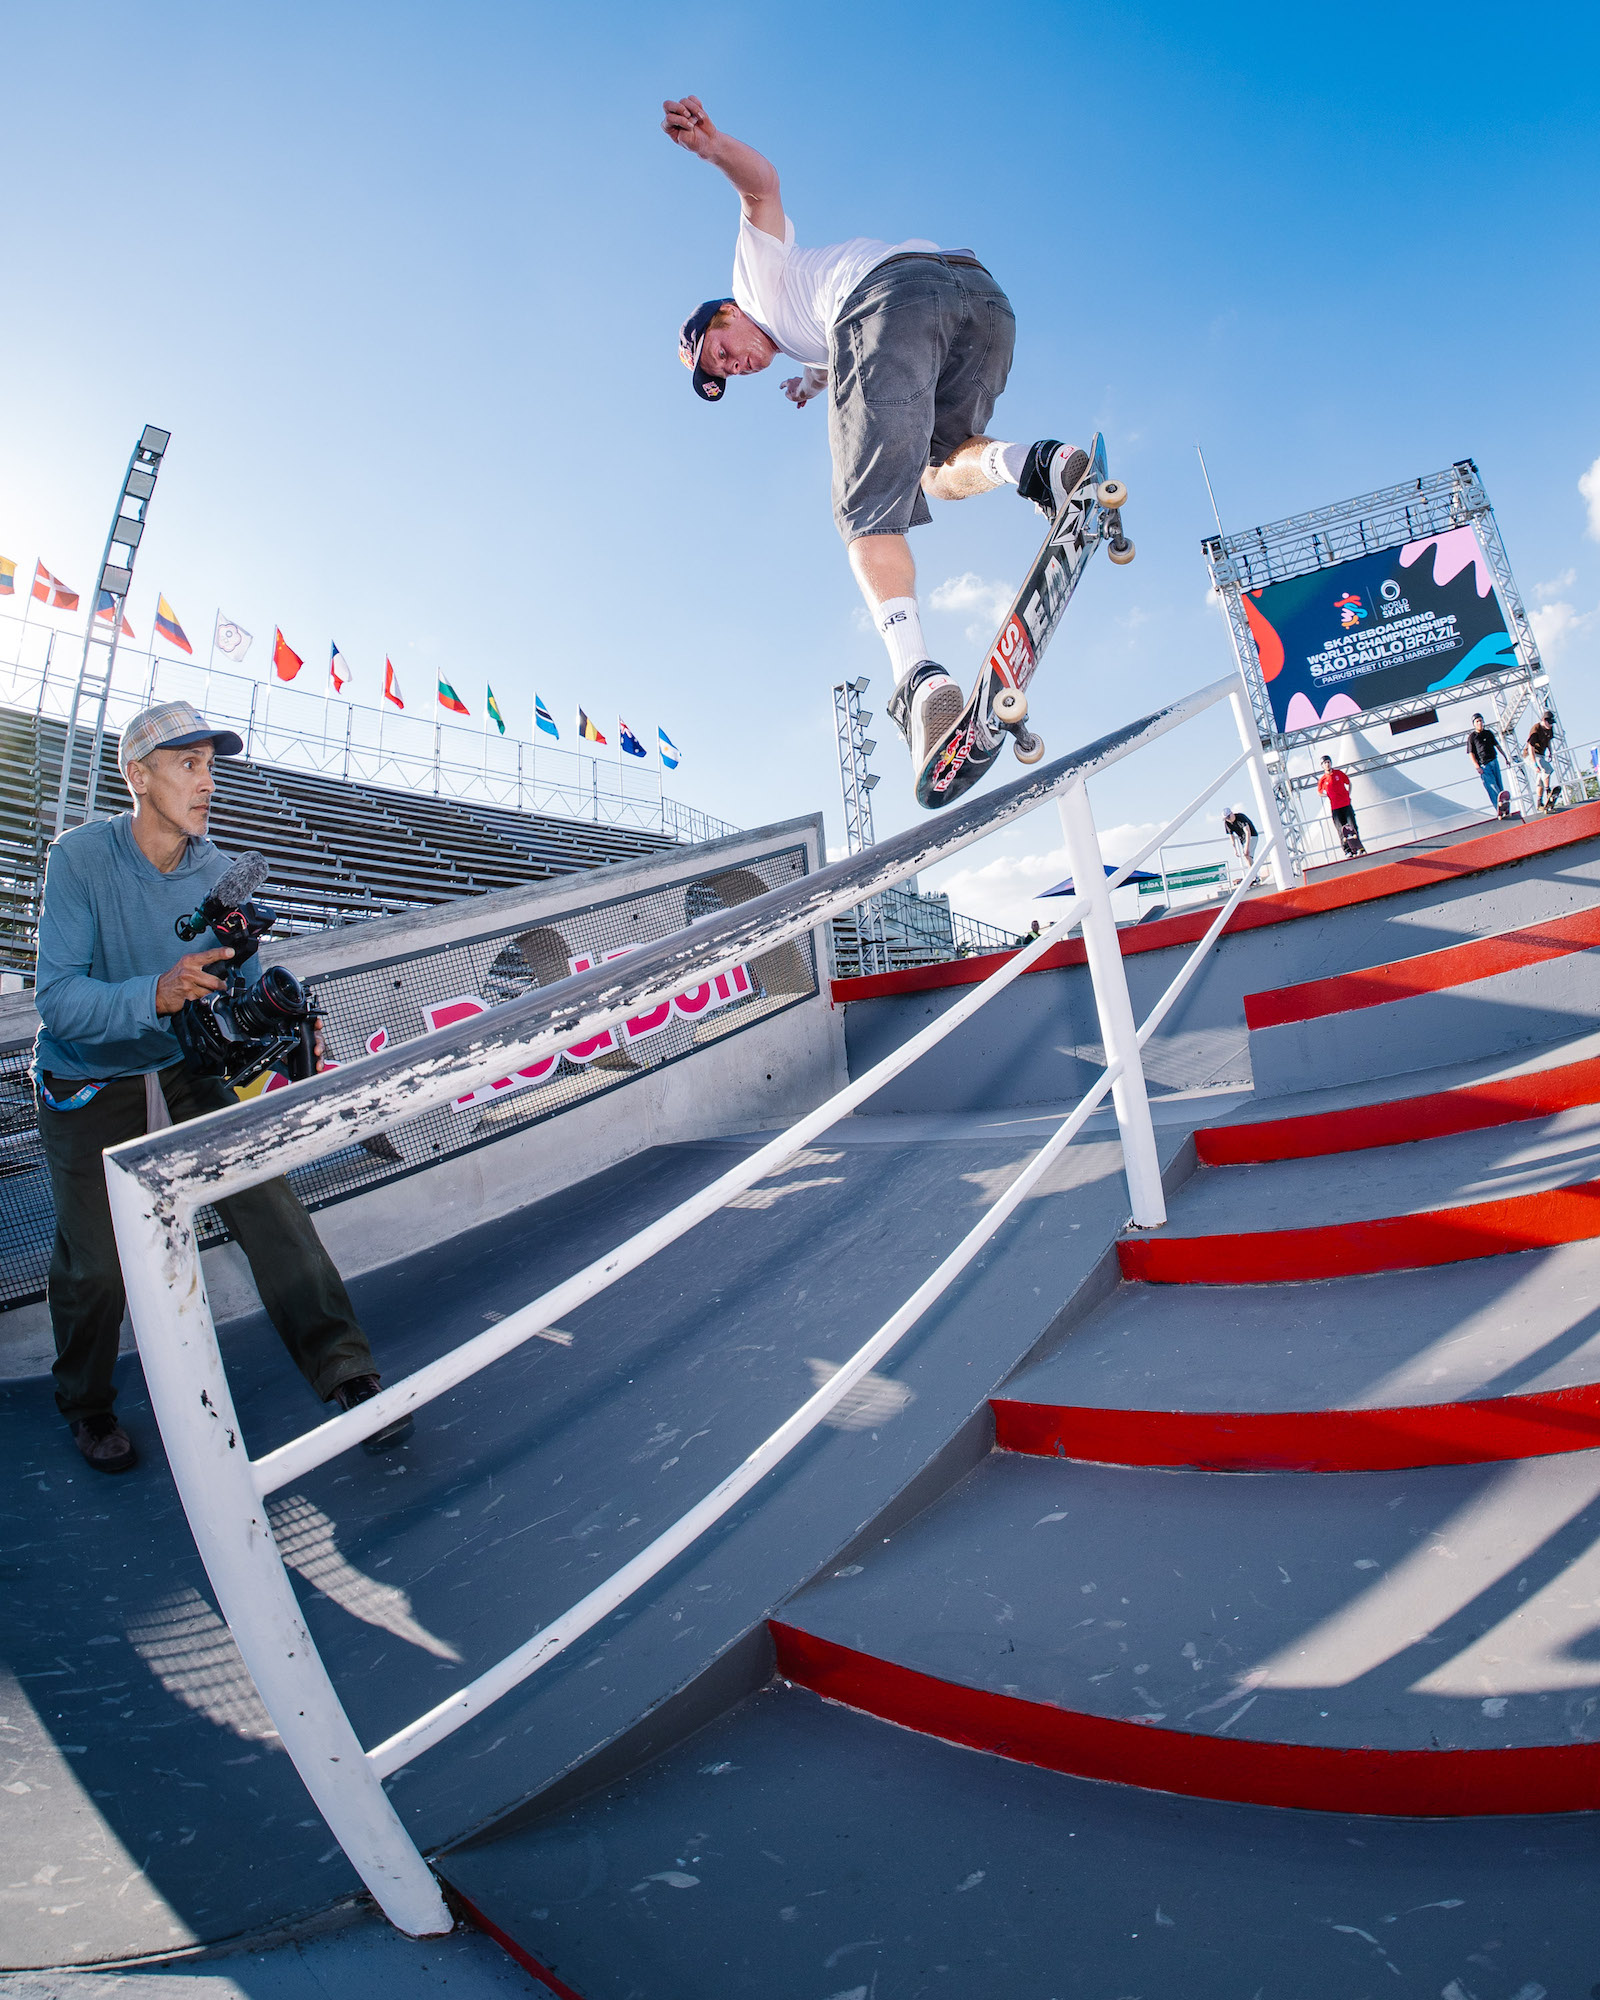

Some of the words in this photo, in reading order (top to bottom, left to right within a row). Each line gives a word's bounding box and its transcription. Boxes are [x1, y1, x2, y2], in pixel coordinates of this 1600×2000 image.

[1380, 598, 1409, 612] WORLD
[1382, 604, 1411, 619] SKATE
[1307, 645, 1354, 665] WORLD
[1356, 614, 1457, 650] CHAMPIONSHIPS
[1324, 611, 1436, 651] SKATEBOARDING
[1310, 657, 1348, 677] SÃO
[1347, 640, 1404, 667] PAULO
[1405, 625, 1460, 651] BRAZIL
[1322, 664, 1377, 684] PARK/STREET
[1382, 656, 1405, 667] 01-08
[1405, 647, 1435, 660] MARCH
[933, 757, 965, 793] Red
[1140, 881, 1159, 889] SAÍDA
